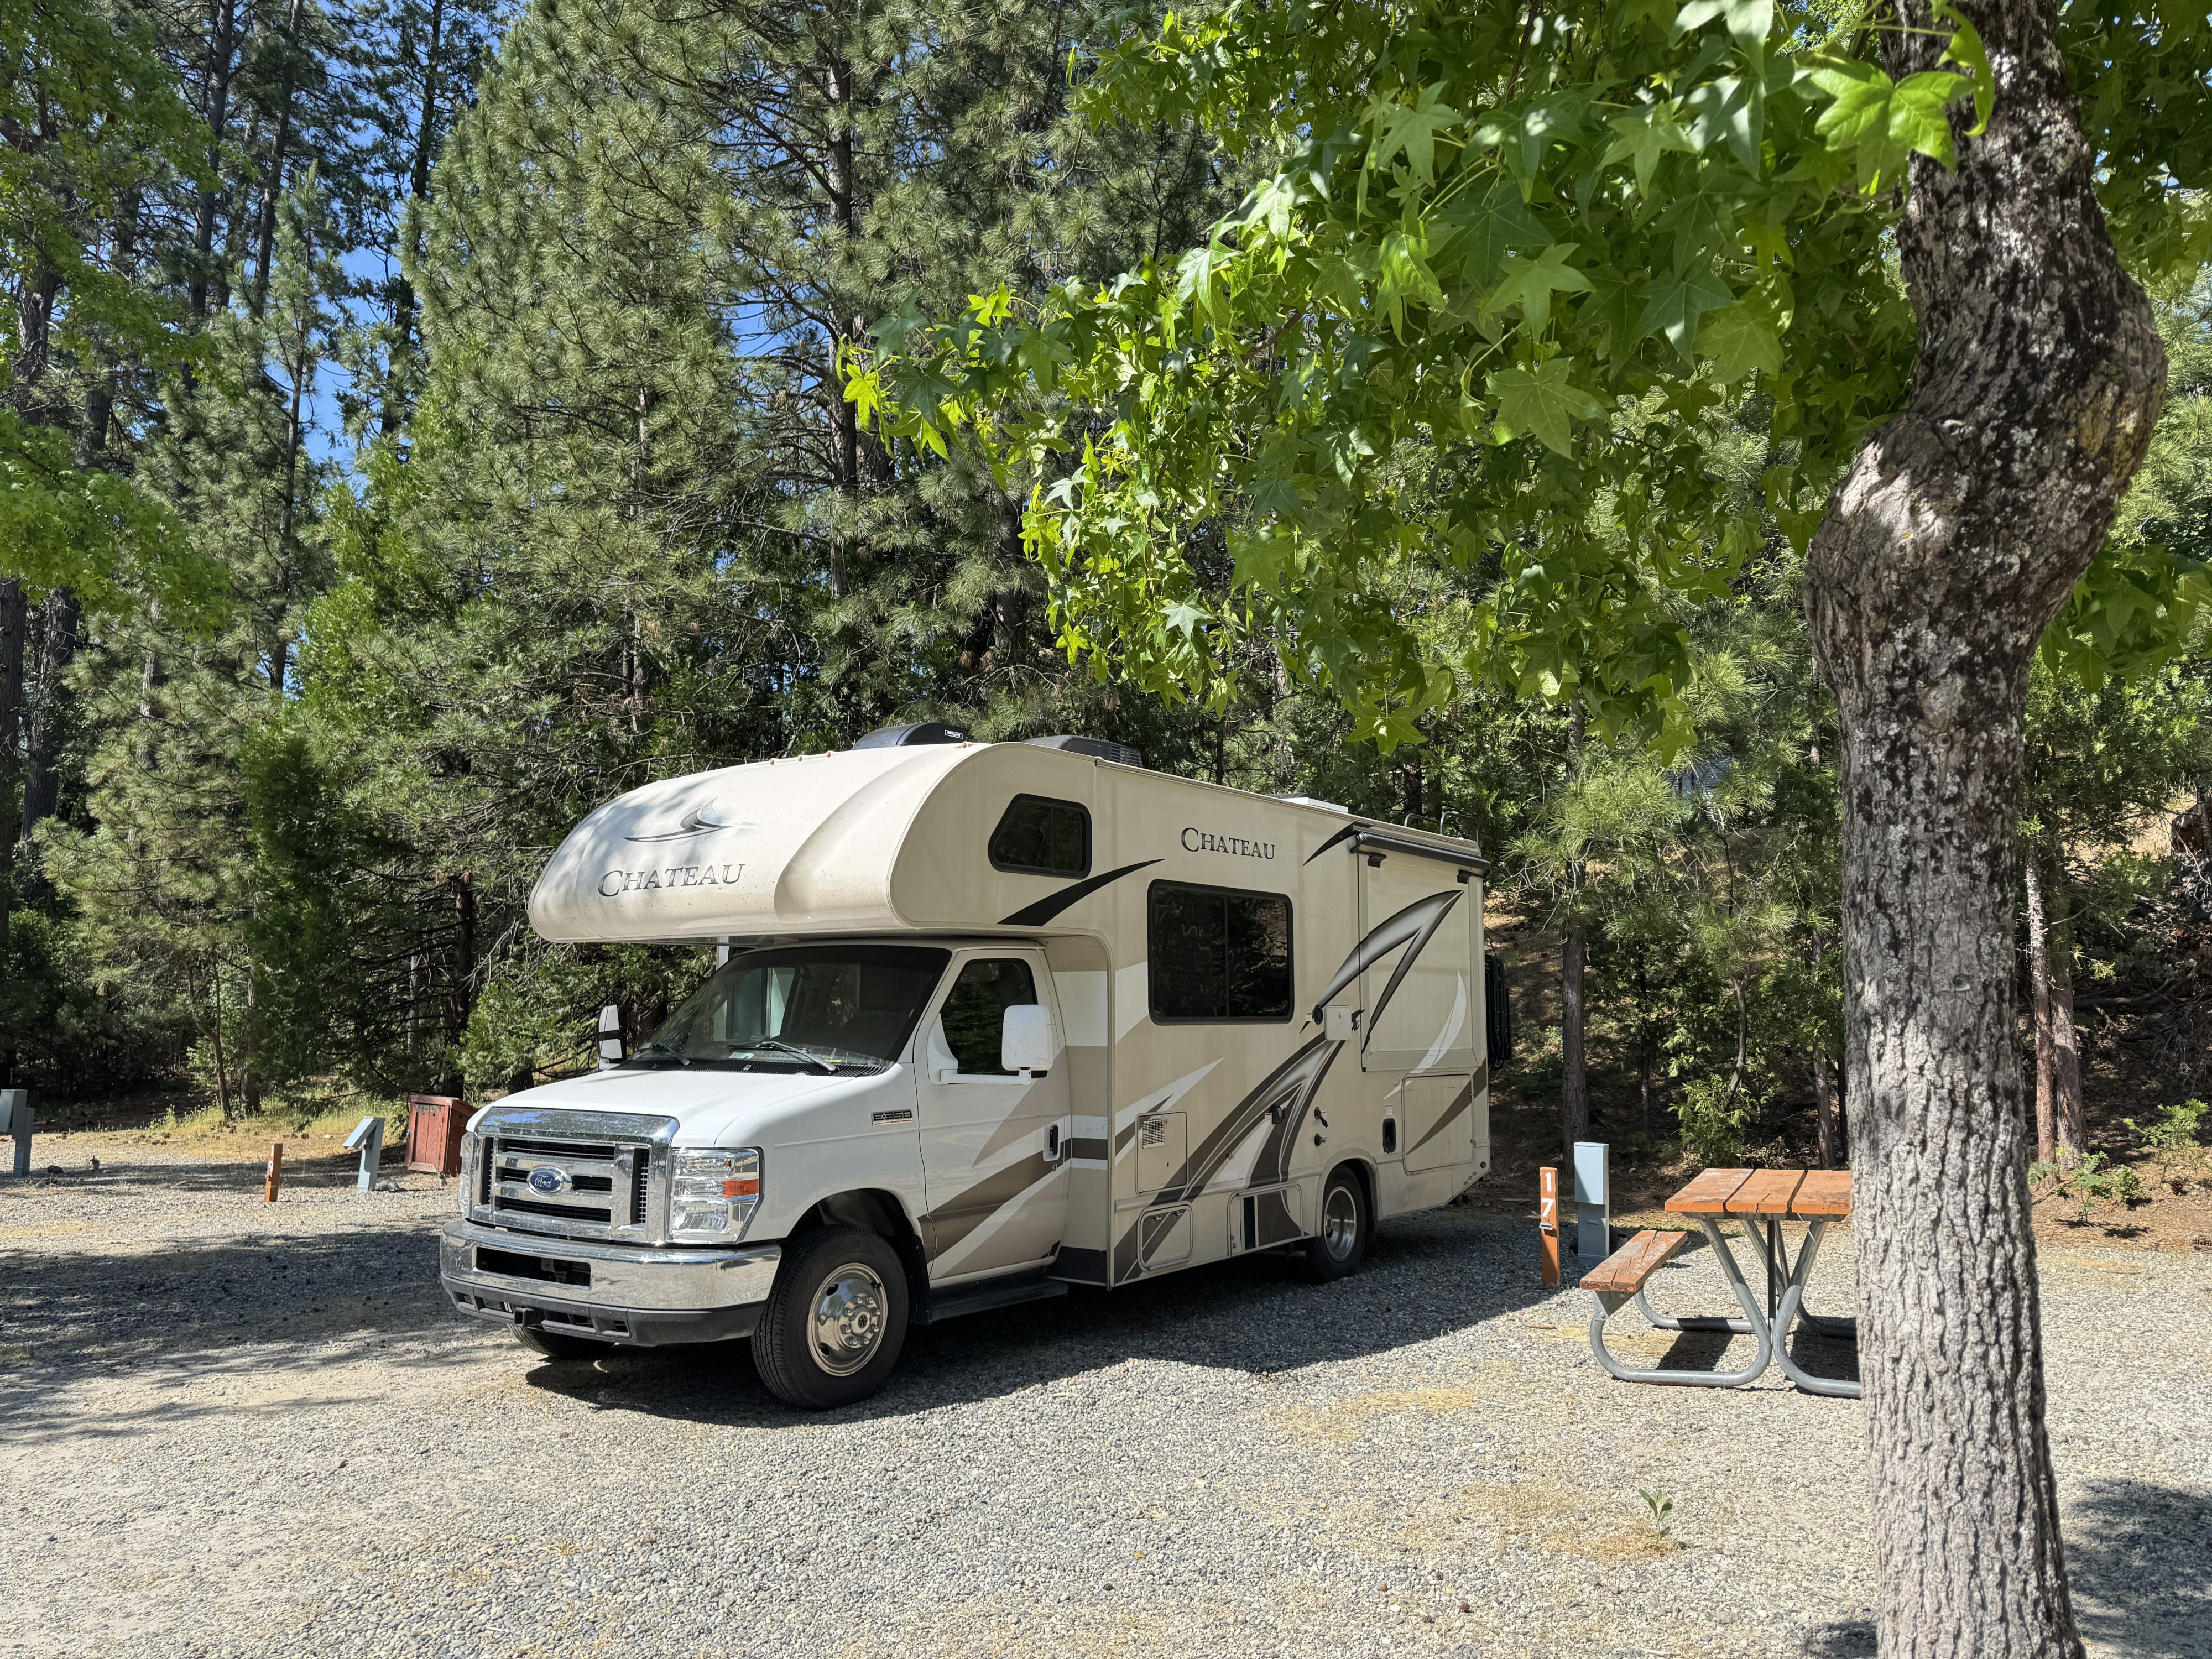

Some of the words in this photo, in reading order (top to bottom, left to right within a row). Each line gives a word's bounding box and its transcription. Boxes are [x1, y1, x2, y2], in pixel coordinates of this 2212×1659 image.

[1181, 827, 1275, 860] CHATEAU
[598, 864, 745, 897] CHATEAU
[535, 1174, 552, 1188] Ford
[1542, 1172, 1554, 1217] 17
